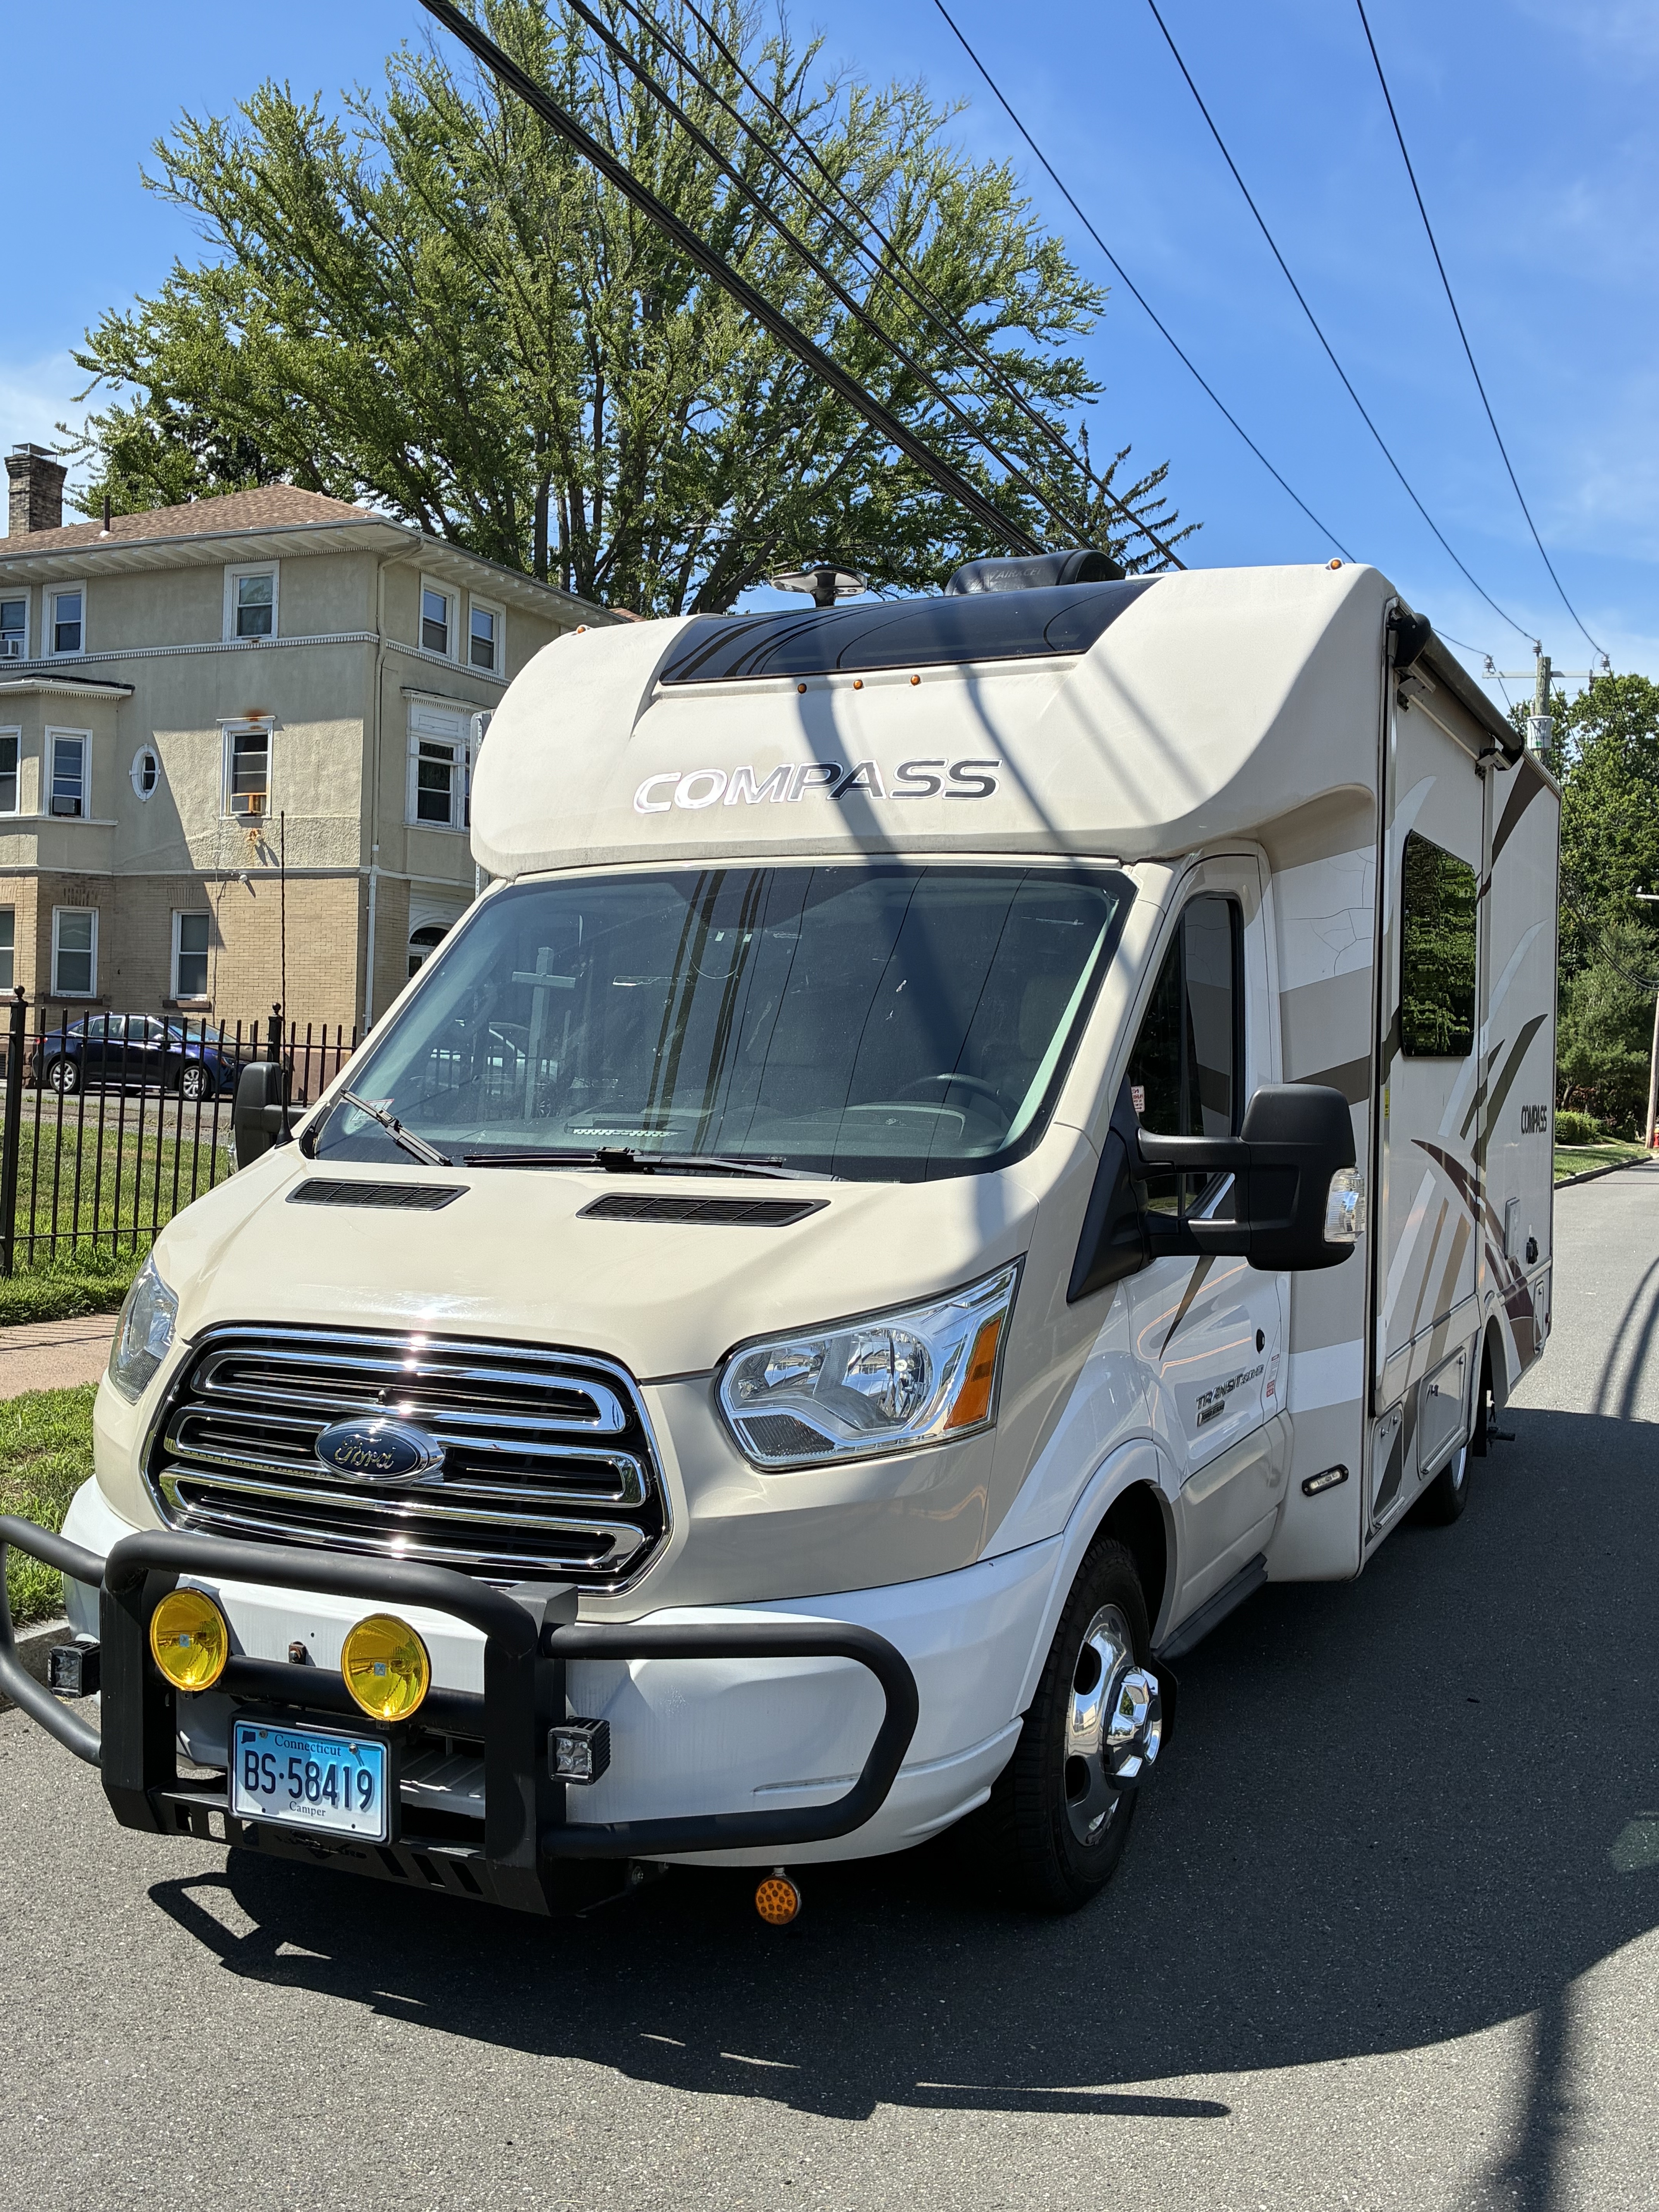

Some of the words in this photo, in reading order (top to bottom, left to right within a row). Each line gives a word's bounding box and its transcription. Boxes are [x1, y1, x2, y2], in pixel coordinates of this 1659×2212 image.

[633, 758, 1003, 814] COMPASS
[1521, 1105, 1547, 1135] COMPASS
[335, 1434, 396, 1469] Ford
[275, 1735, 342, 1757] Connecticut
[289, 1801, 326, 1817] Camper
